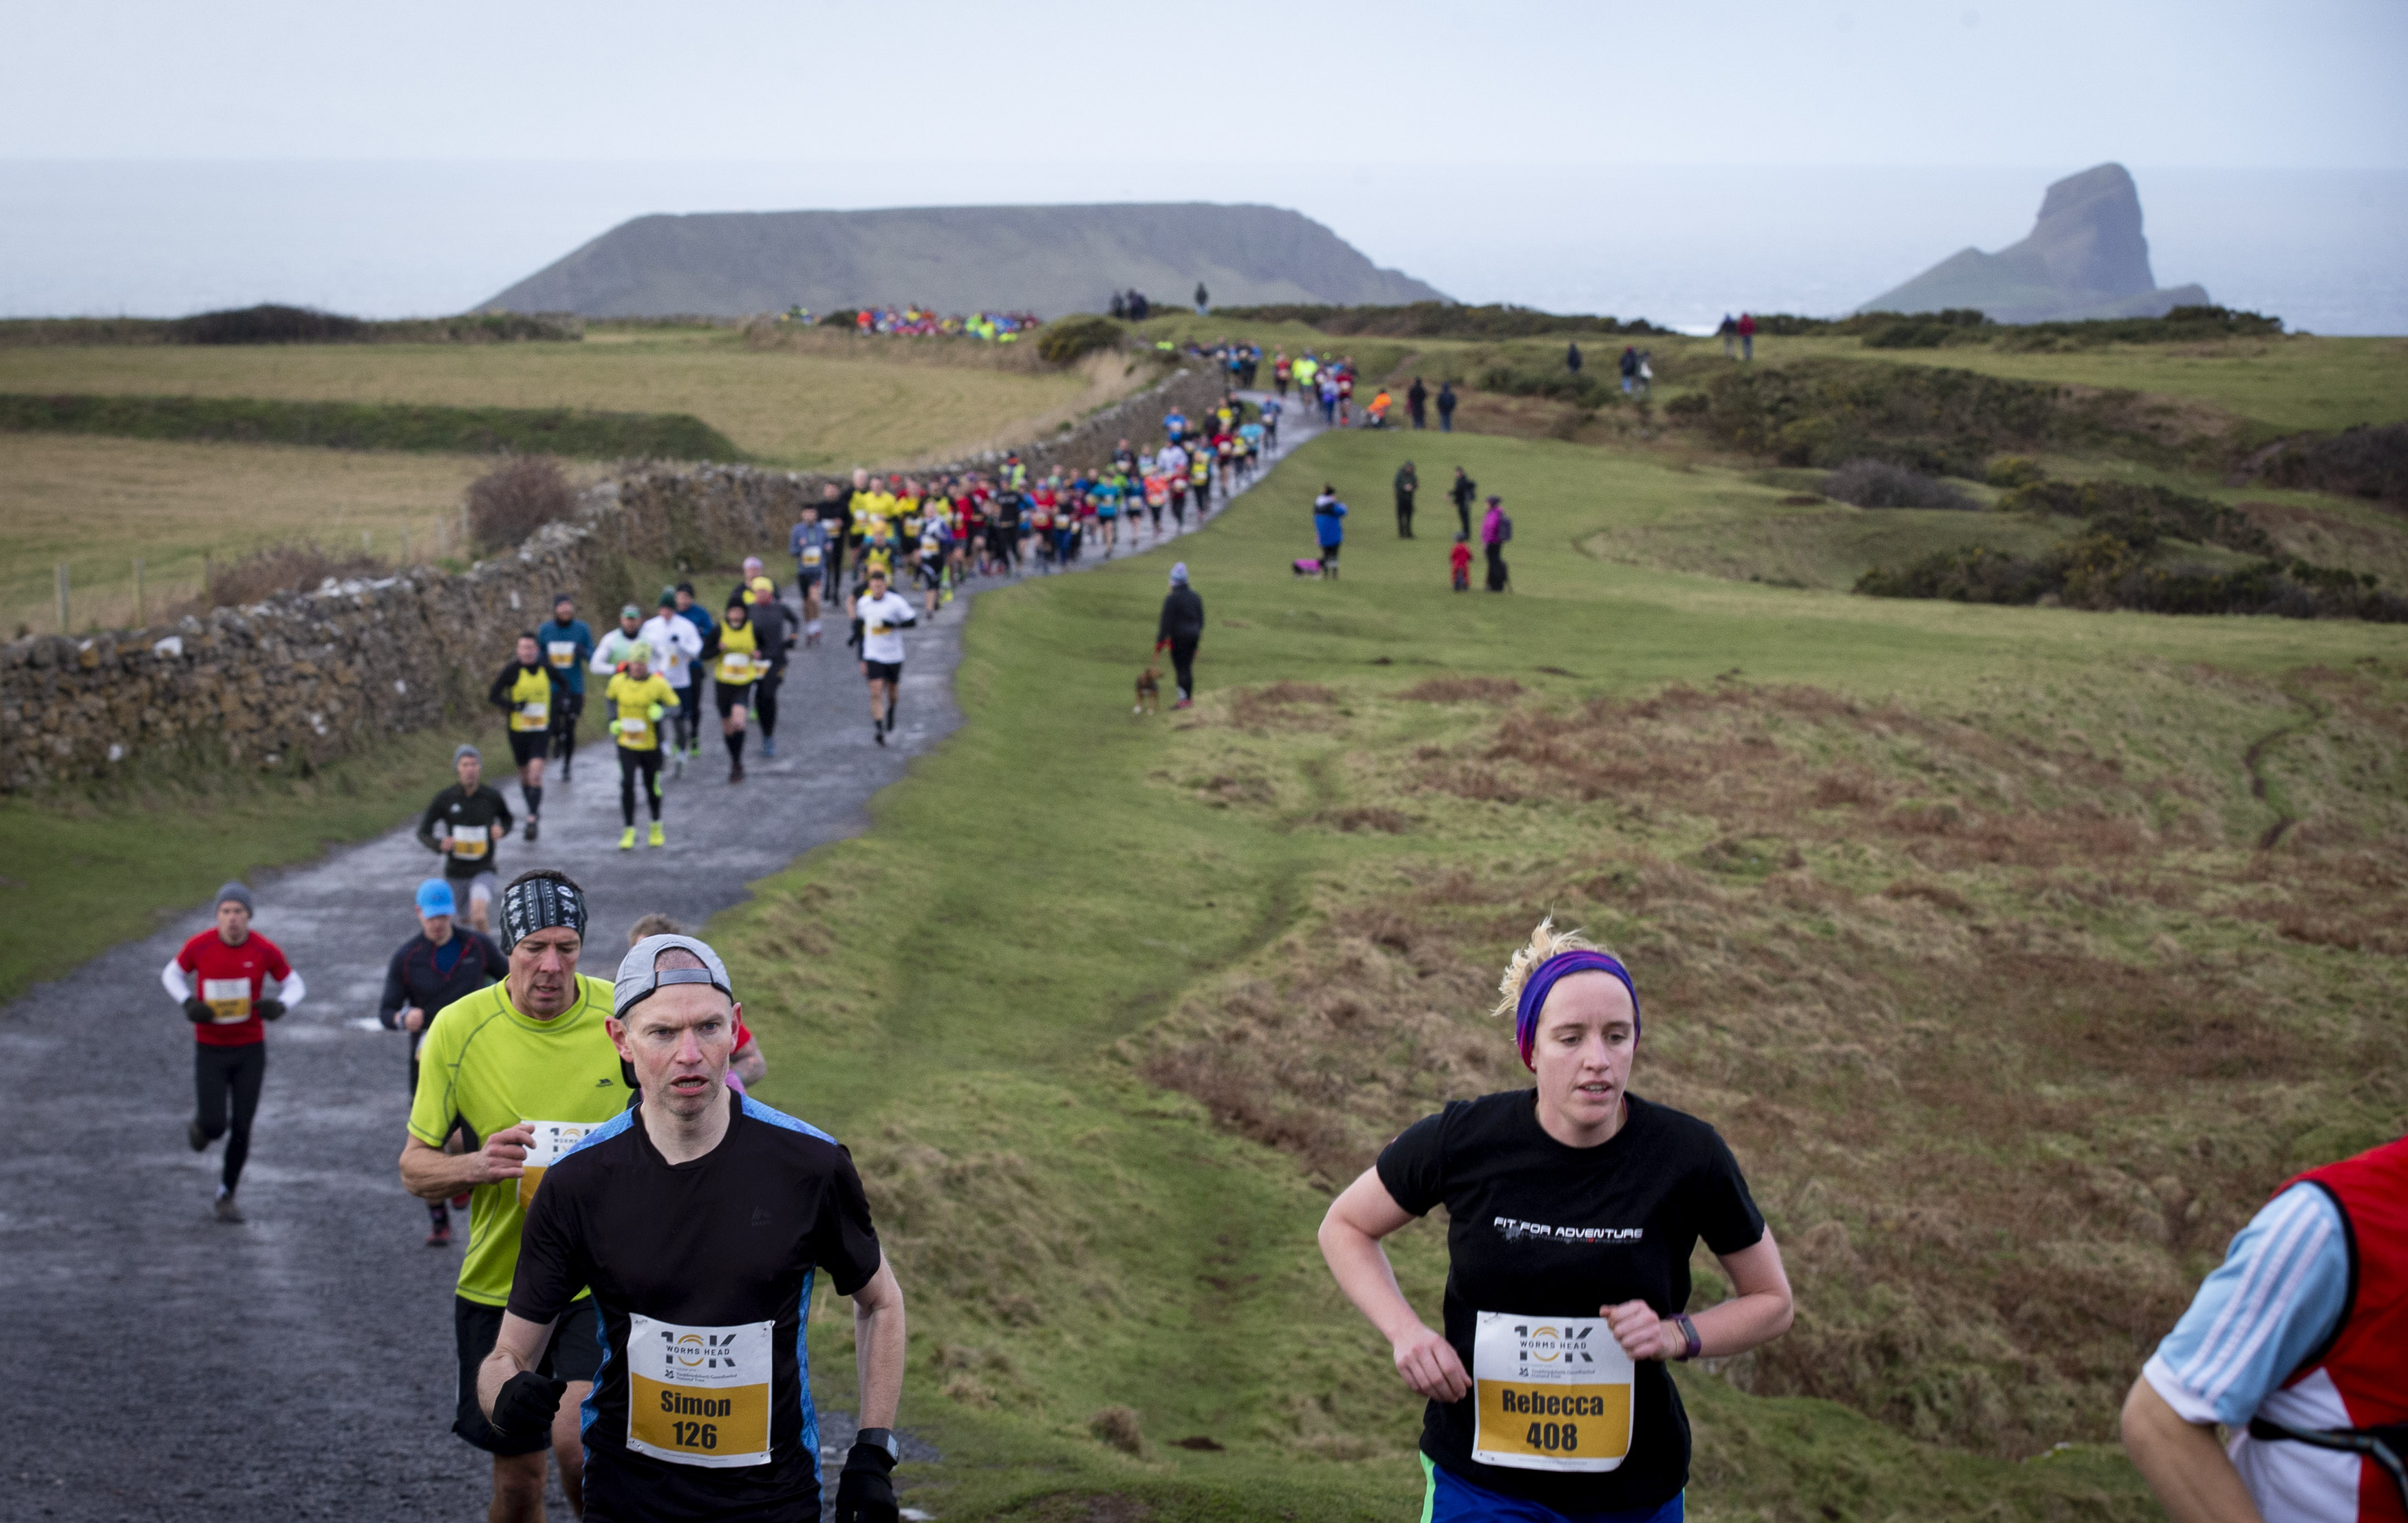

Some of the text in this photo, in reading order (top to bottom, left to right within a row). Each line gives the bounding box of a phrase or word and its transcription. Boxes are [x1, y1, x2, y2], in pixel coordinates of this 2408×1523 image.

[1494, 1216, 1643, 1239] FIT FOR ADVENTURE
[666, 1346, 700, 1354] WORMS
[1520, 1341, 1555, 1349] WORMS
[660, 1390, 731, 1417] Simon
[1502, 1389, 1604, 1416] Rebecca
[672, 1421, 717, 1449] 126
[1526, 1422, 1578, 1451] 408
